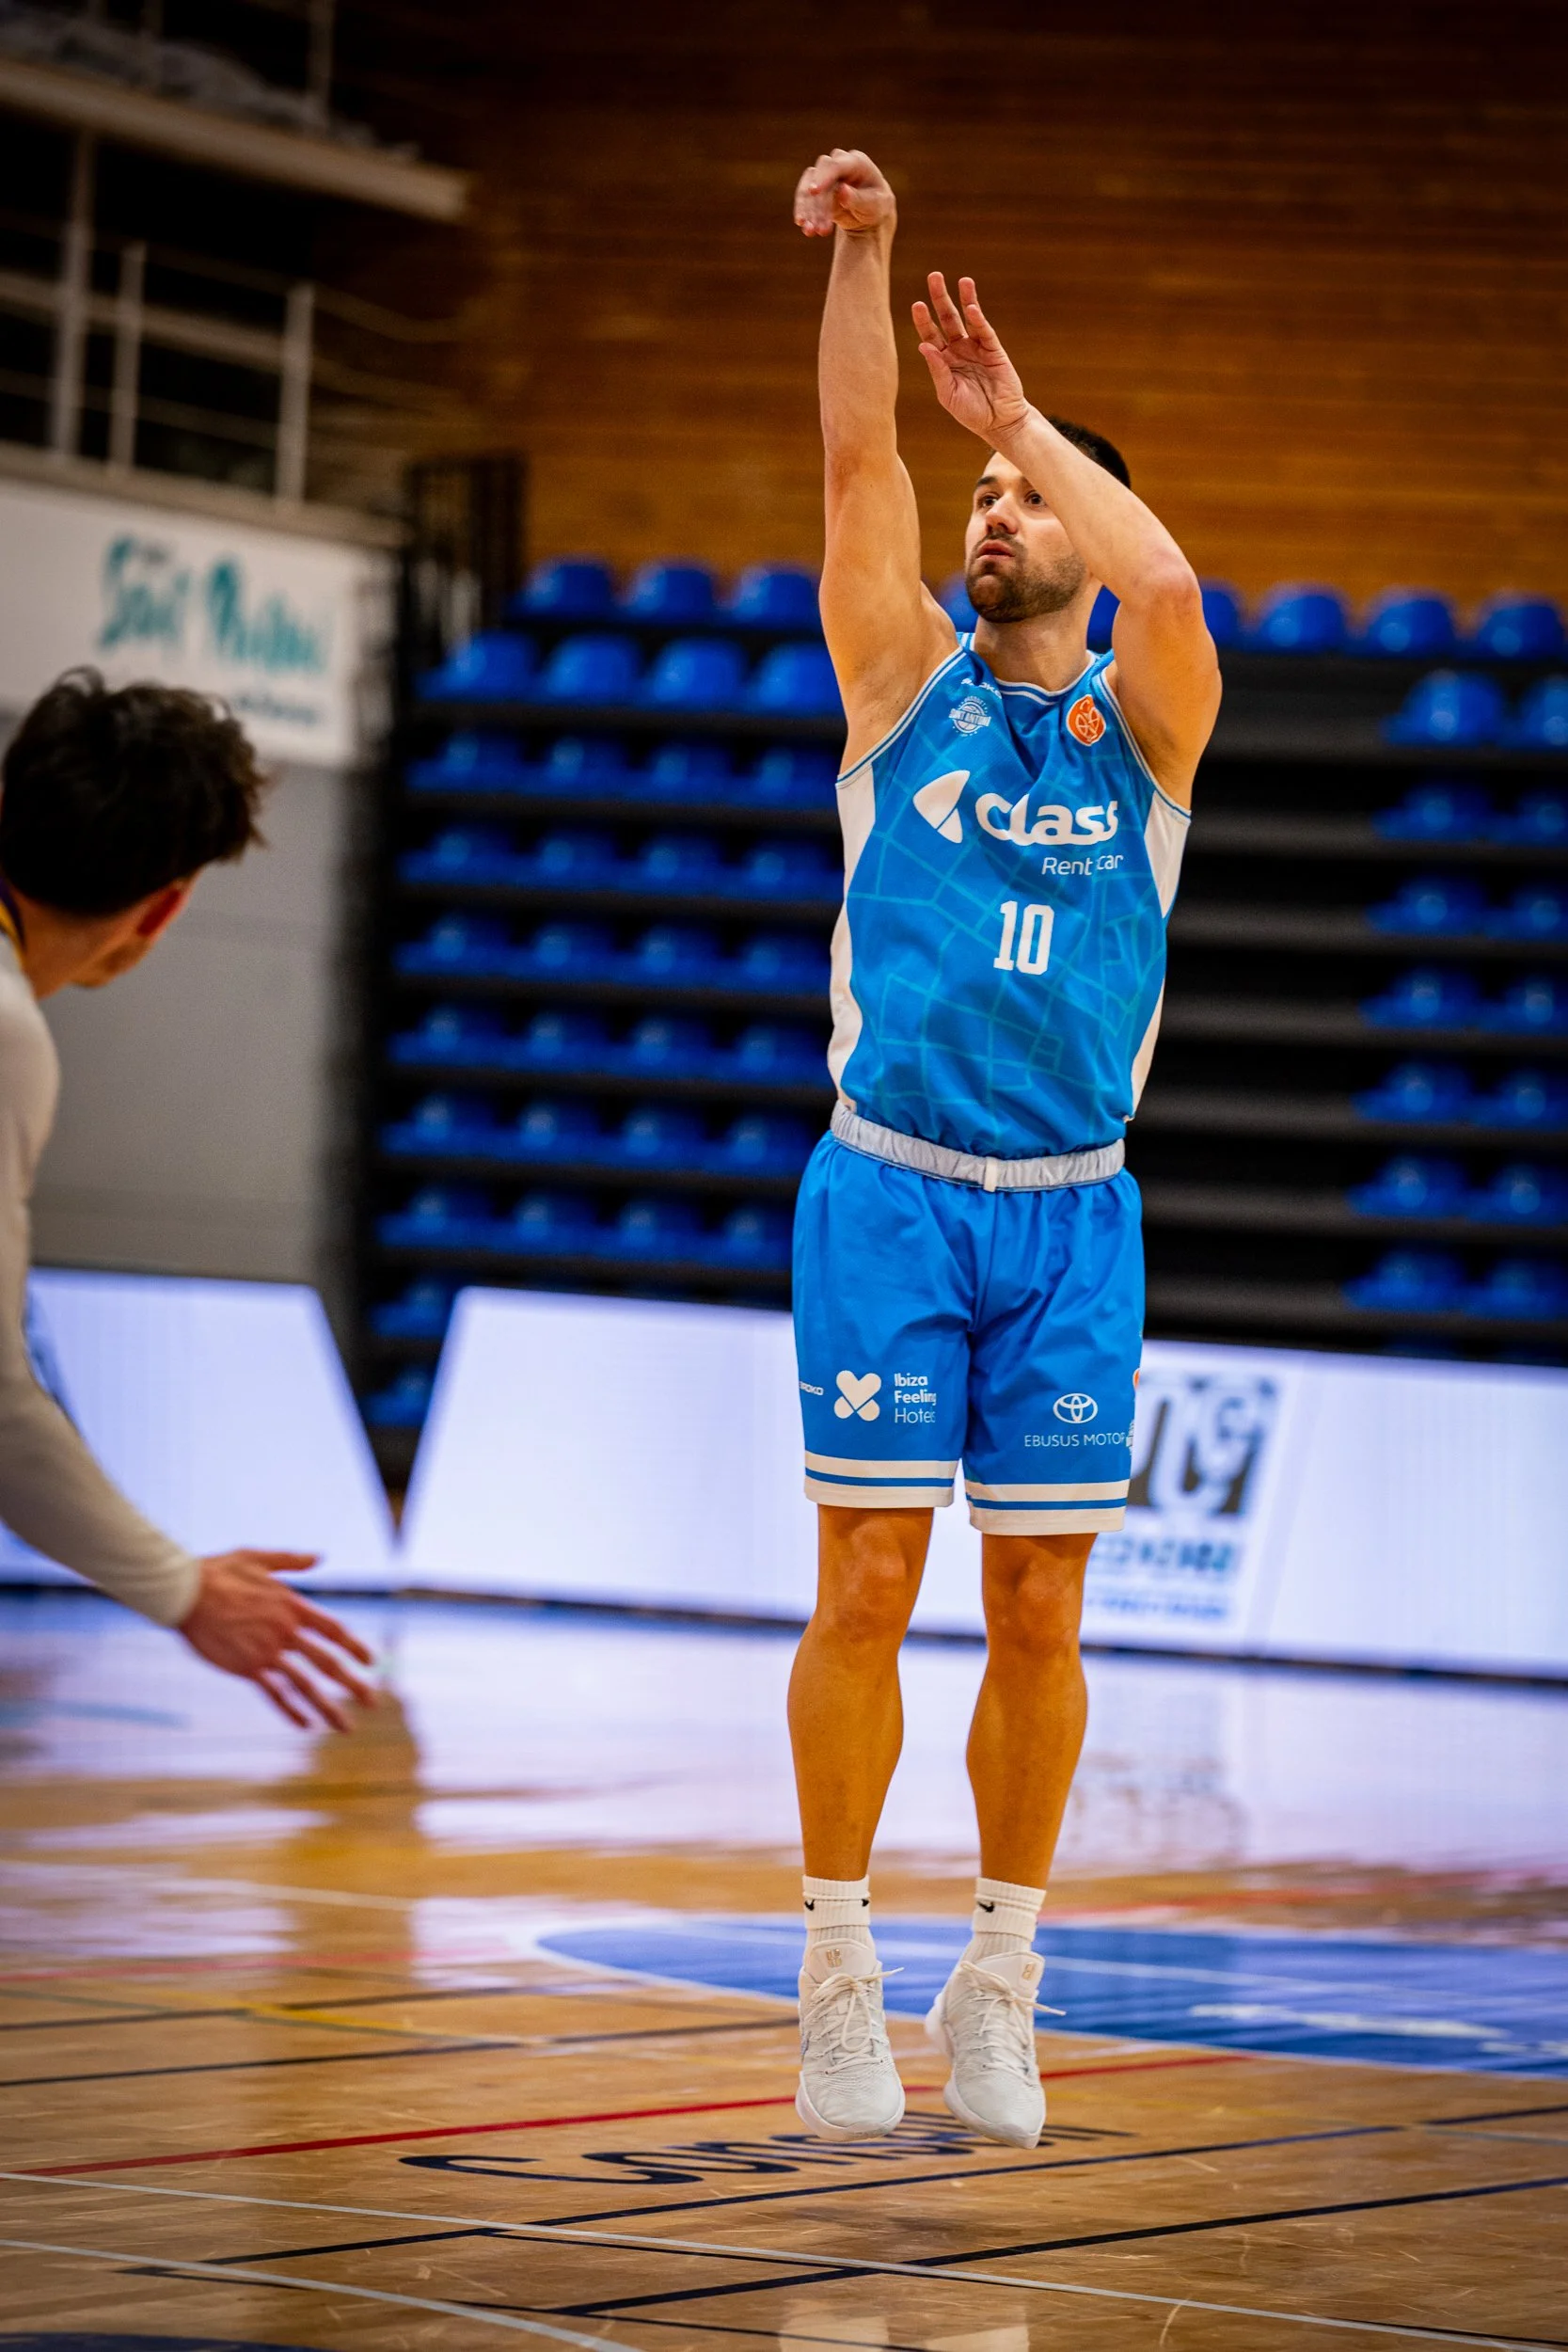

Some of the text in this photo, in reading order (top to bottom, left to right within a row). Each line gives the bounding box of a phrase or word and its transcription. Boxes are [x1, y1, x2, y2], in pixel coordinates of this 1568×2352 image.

[1041, 856, 1093, 876] Rent
[993, 900, 1054, 976] 10
[894, 1373, 928, 1387] Ibiza
[1023, 1434, 1080, 1447] EBUSUS
